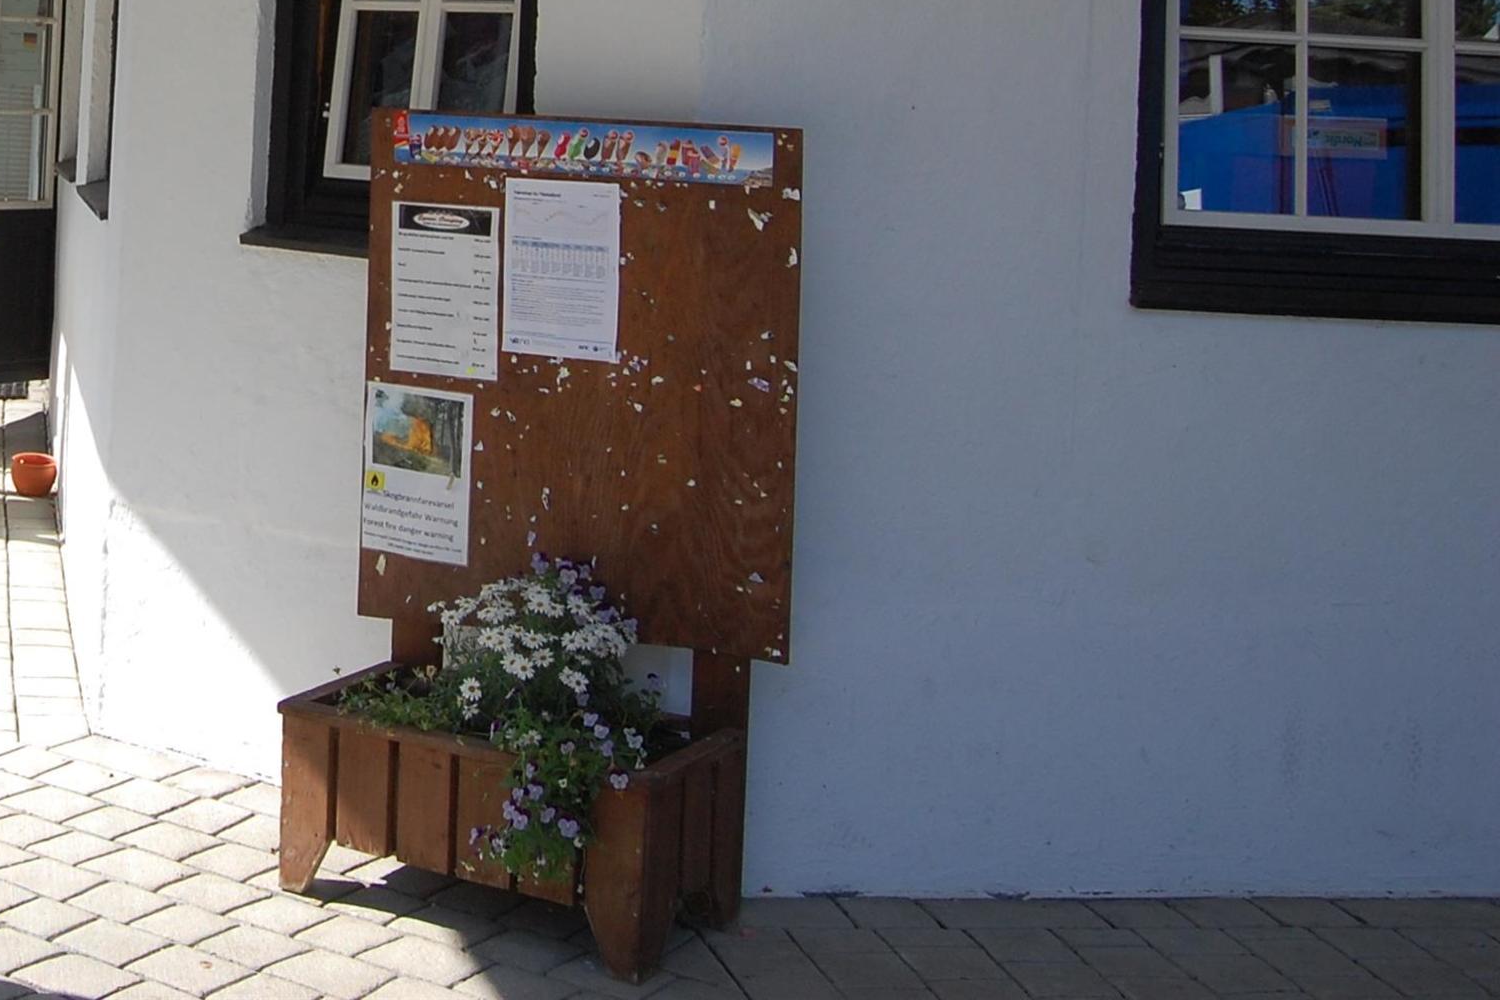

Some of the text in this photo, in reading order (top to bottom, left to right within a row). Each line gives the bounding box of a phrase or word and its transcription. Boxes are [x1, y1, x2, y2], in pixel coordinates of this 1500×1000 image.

[363, 517, 384, 529] Forest
[385, 521, 397, 531] fire
[398, 524, 422, 536] danger
[424, 531, 454, 543] warning
[425, 513, 458, 528] Warnung
